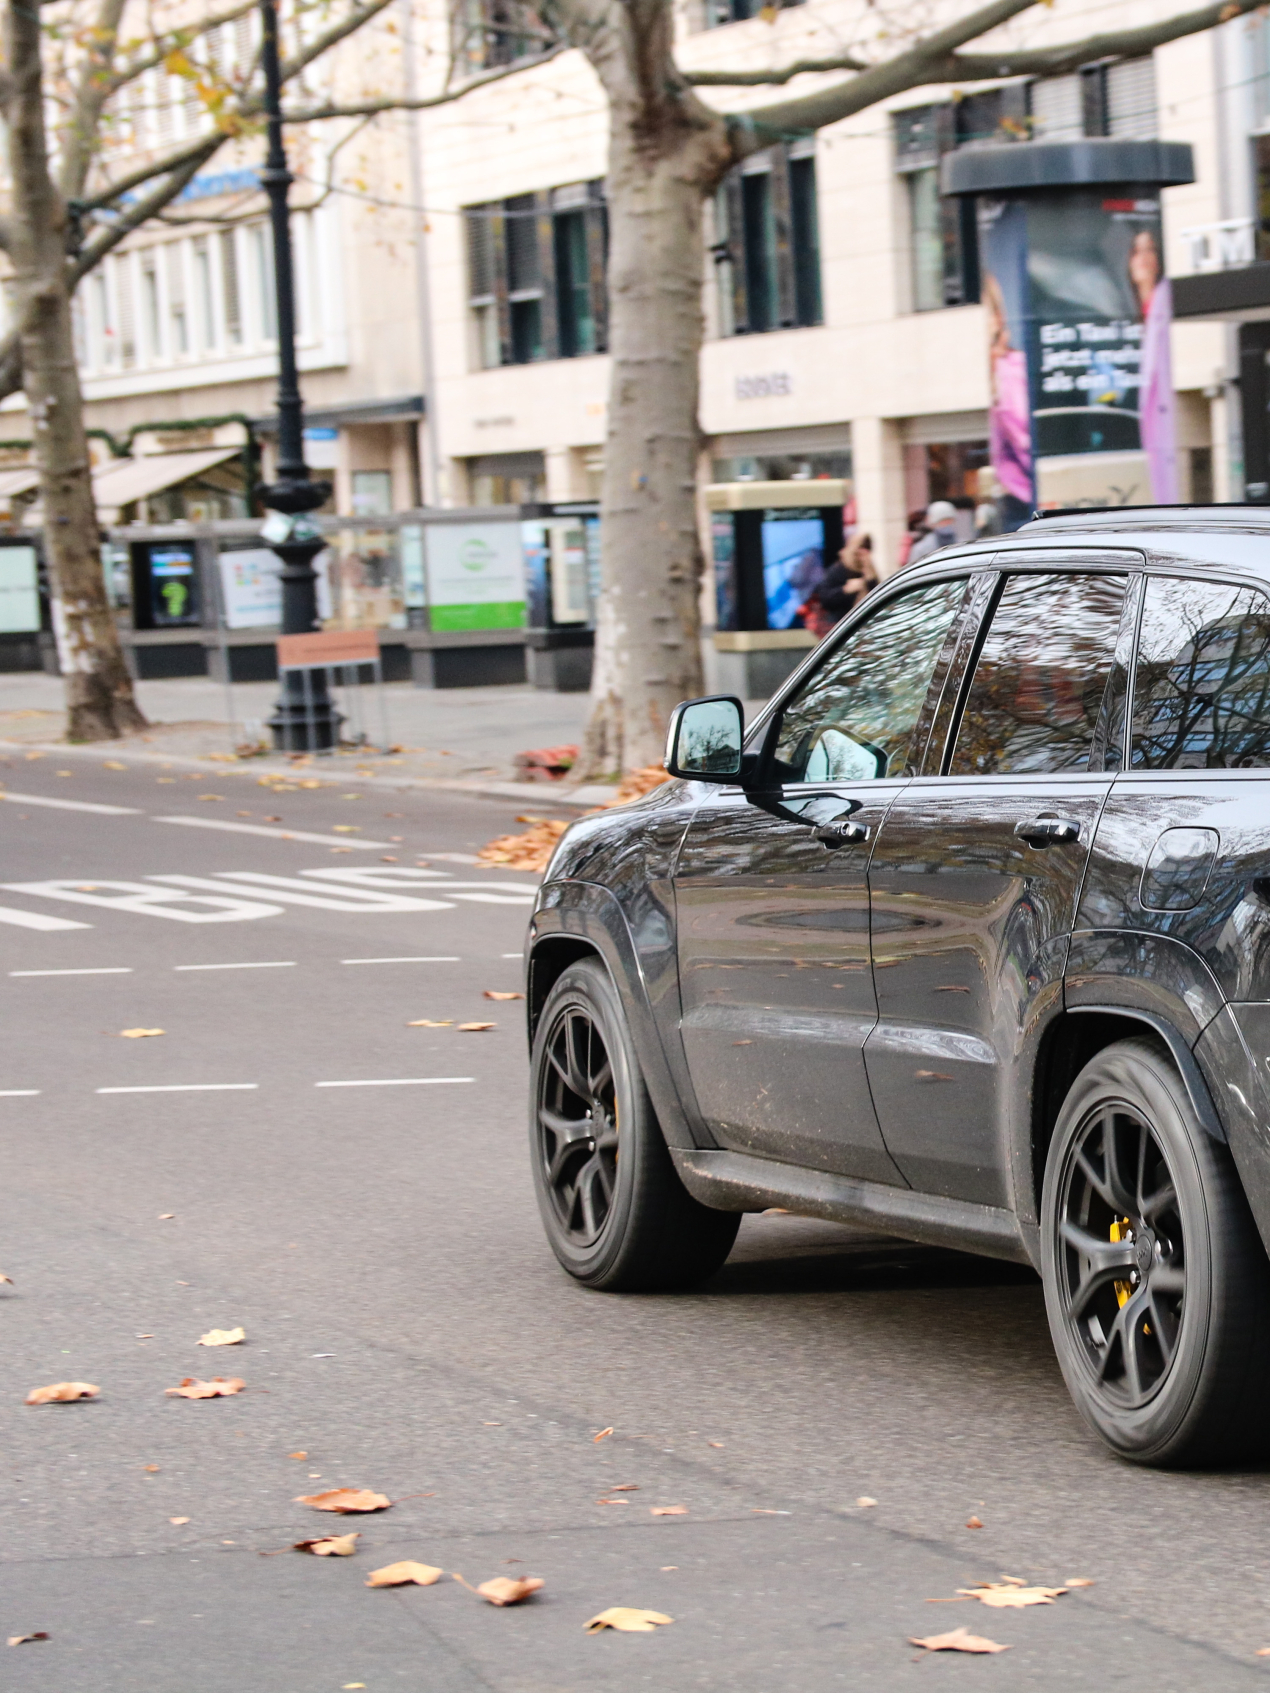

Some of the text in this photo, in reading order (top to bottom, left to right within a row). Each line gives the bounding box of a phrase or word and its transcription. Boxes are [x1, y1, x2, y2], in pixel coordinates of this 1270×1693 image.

[1040, 322, 1077, 344] Ein
[1076, 321, 1119, 341] Taxi
[1041, 347, 1093, 372] jetzt
[1042, 371, 1074, 392] als
[1075, 369, 1110, 390] ein
[0, 867, 541, 924] BUS
